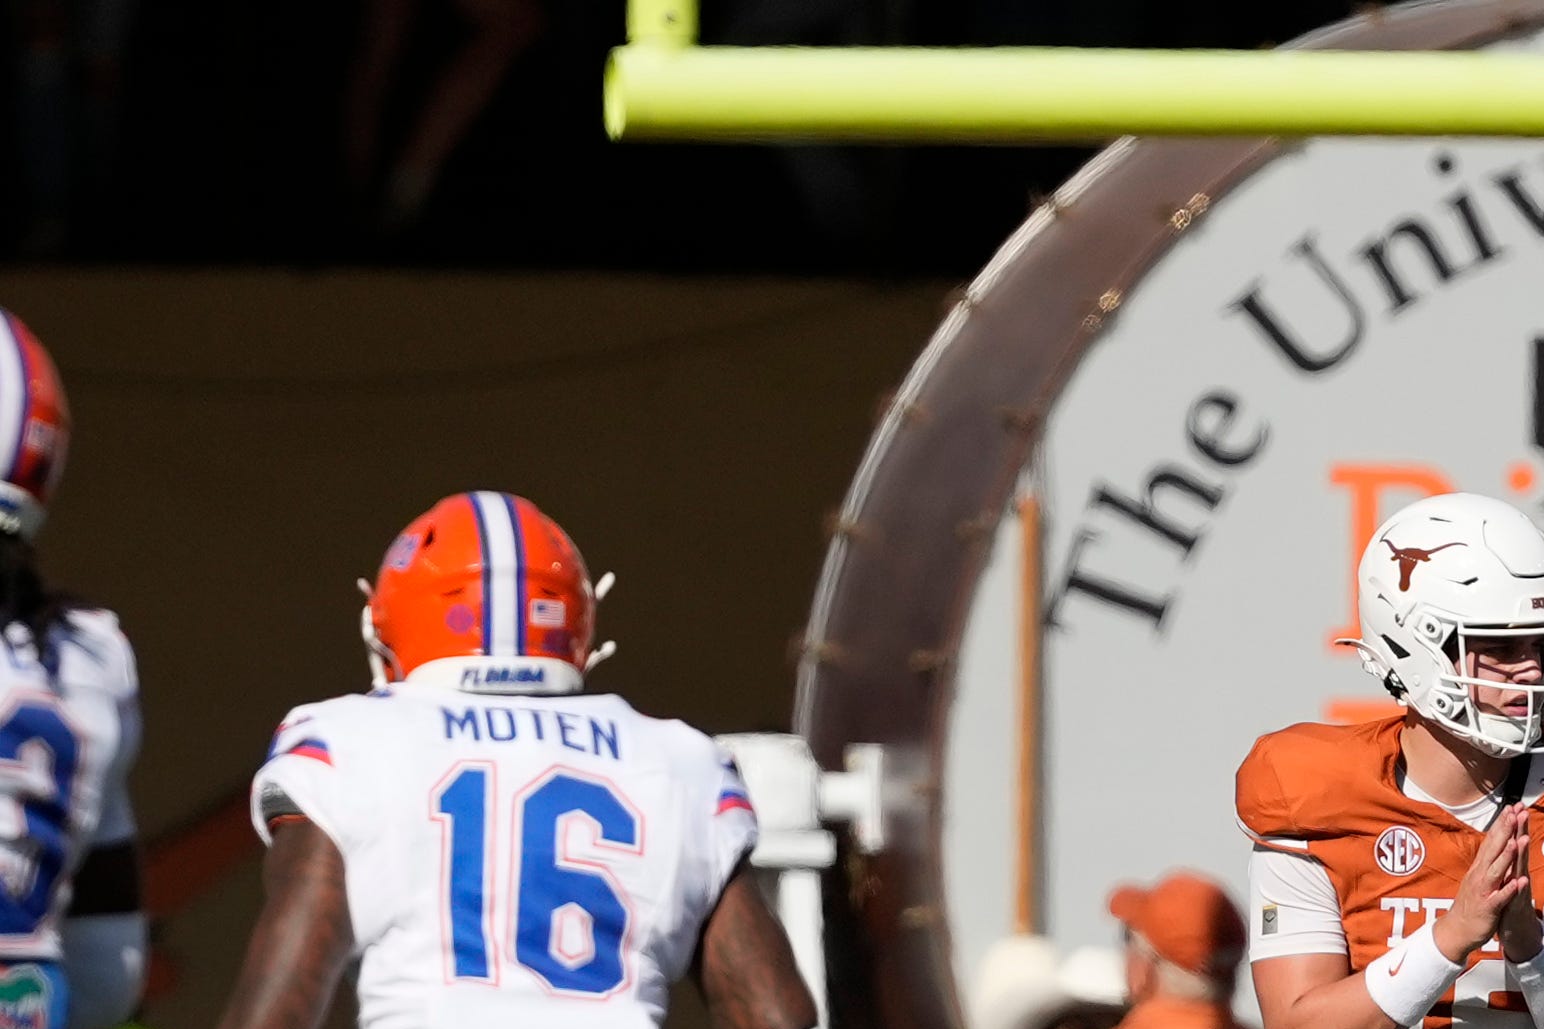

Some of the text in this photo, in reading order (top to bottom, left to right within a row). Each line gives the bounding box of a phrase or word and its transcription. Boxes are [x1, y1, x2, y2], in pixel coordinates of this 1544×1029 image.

[1043, 388, 1268, 634] The
[440, 704, 622, 760] MOTEN
[429, 760, 645, 1001] 16
[1377, 829, 1422, 874] SEC
